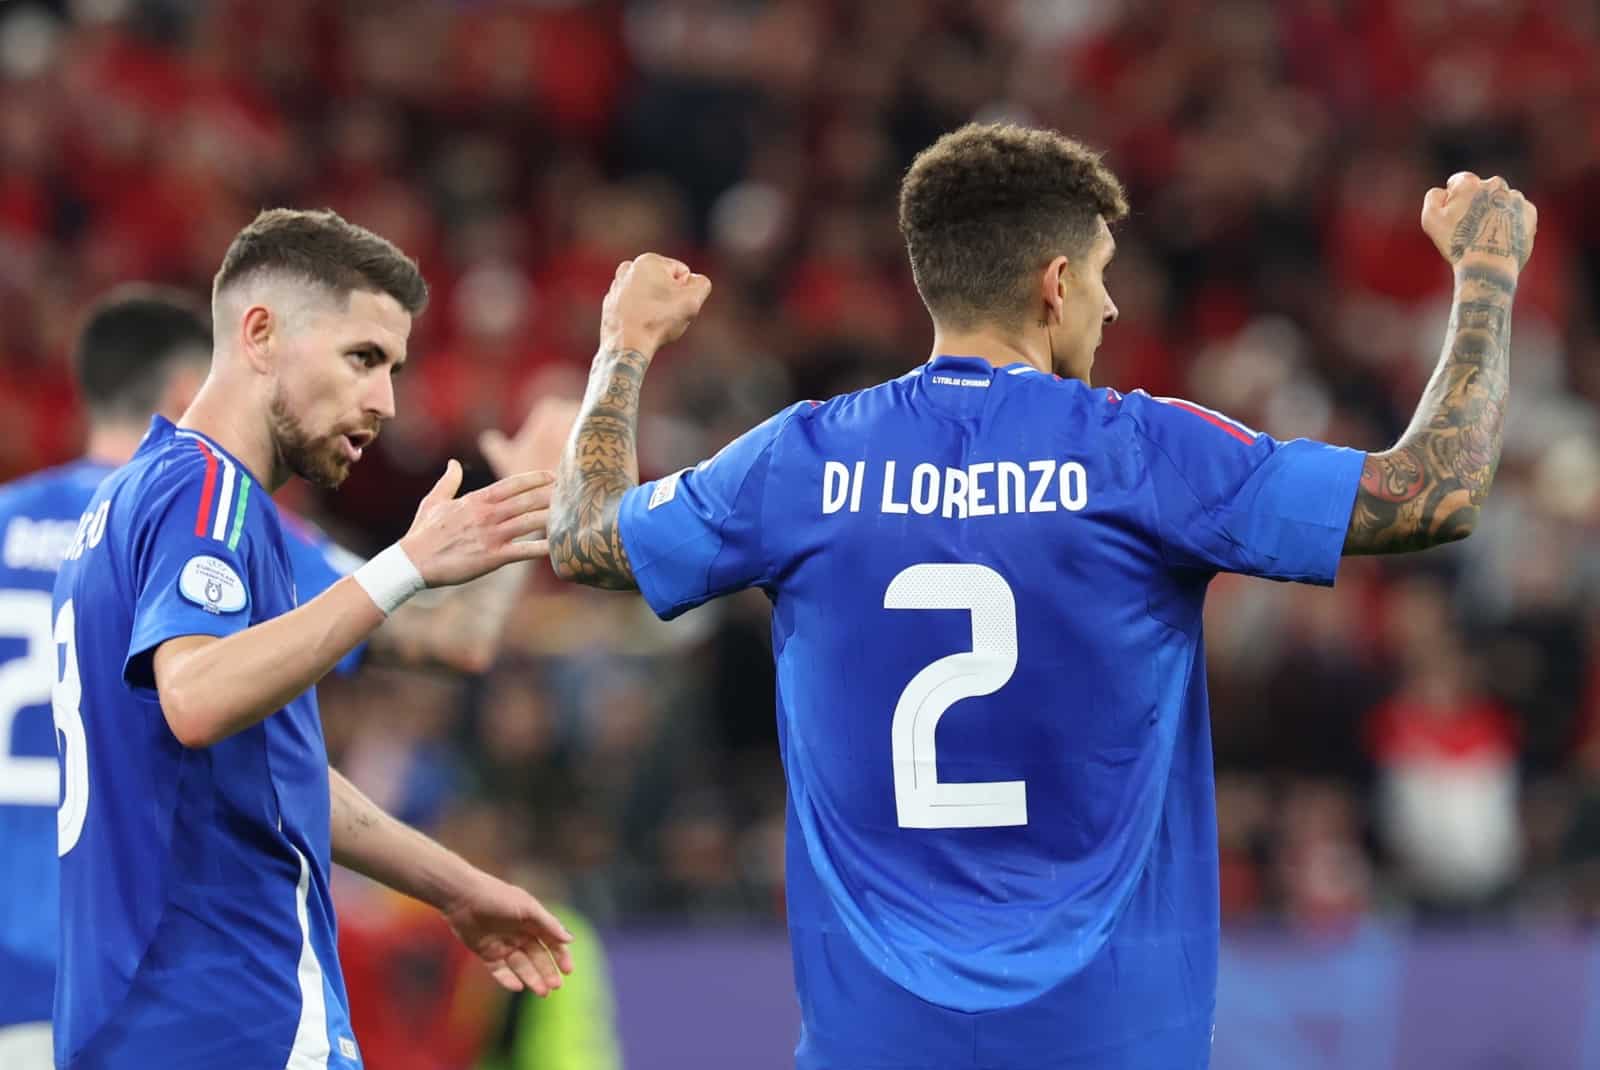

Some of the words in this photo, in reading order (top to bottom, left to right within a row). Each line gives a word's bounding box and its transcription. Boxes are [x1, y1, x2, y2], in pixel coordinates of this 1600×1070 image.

[822, 461, 866, 514] DI
[881, 459, 1088, 519] LORENZO
[883, 563, 1028, 829] 2
